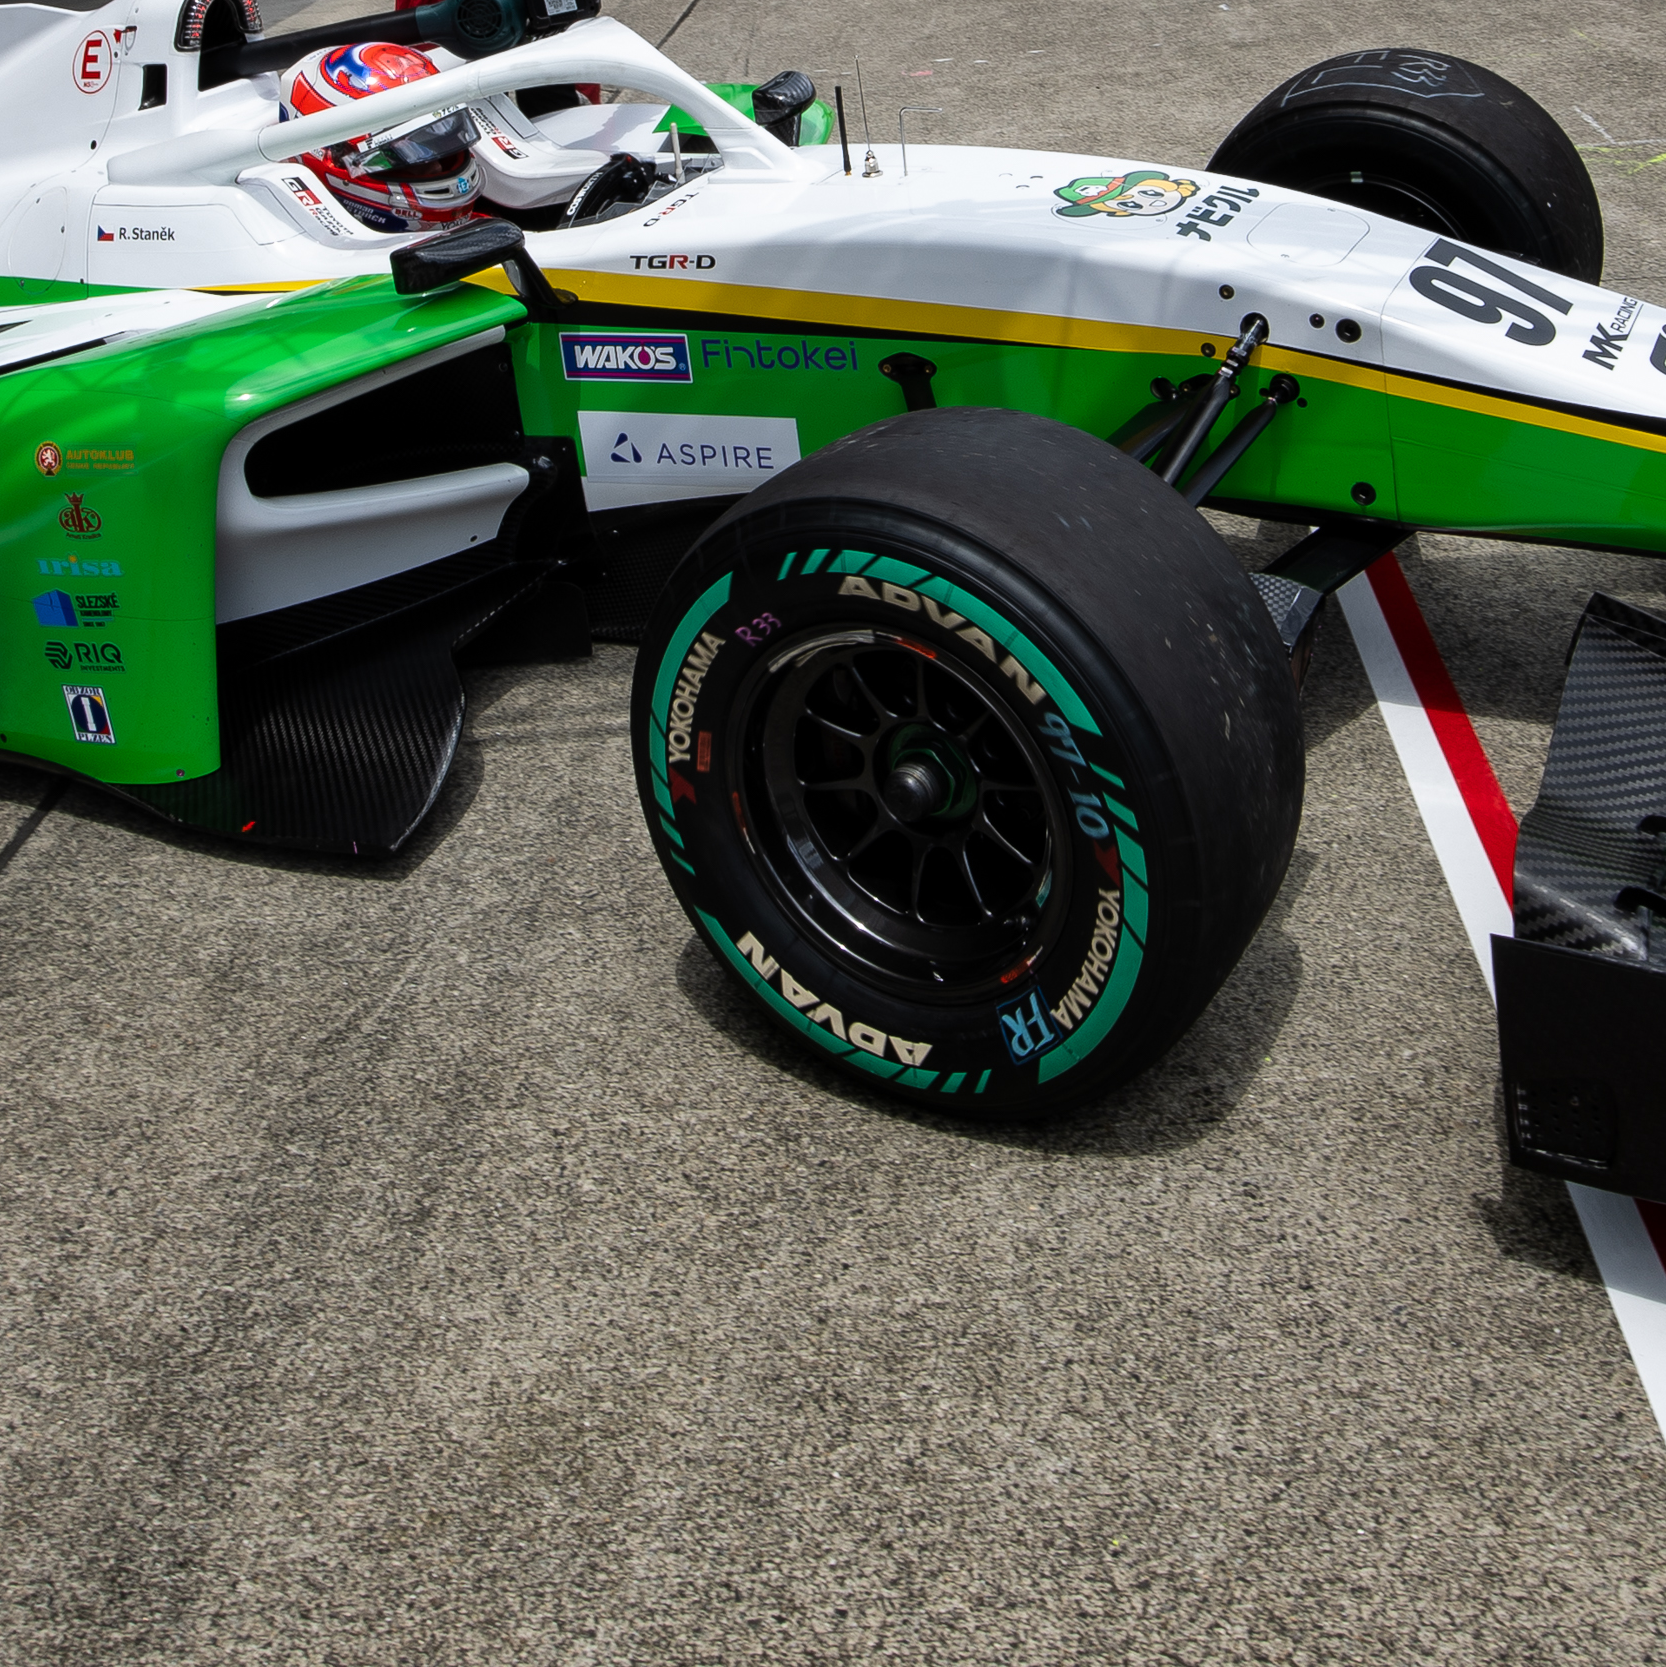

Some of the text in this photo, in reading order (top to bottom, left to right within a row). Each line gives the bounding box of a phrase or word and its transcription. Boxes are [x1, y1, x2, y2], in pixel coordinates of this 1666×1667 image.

[81, 39, 102, 79] E
[395, 208, 419, 219] BELL
[1175, 185, 1260, 242] ナビクル
[630, 254, 716, 270] TGR-D
[1409, 237, 1573, 347] 97
[1610, 297, 1639, 333] RACING
[701, 338, 859, 371] Fintokei
[66, 449, 134, 461] AUTOKLUB
[657, 443, 774, 470] ASPIRE
[73, 642, 123, 663] RIQ
[837, 574, 1046, 704] ADVAN
[669, 632, 725, 763] YOKOHAMA
[1051, 889, 1121, 1031] YOKOHAMA
[736, 931, 933, 1067] ADVAN
